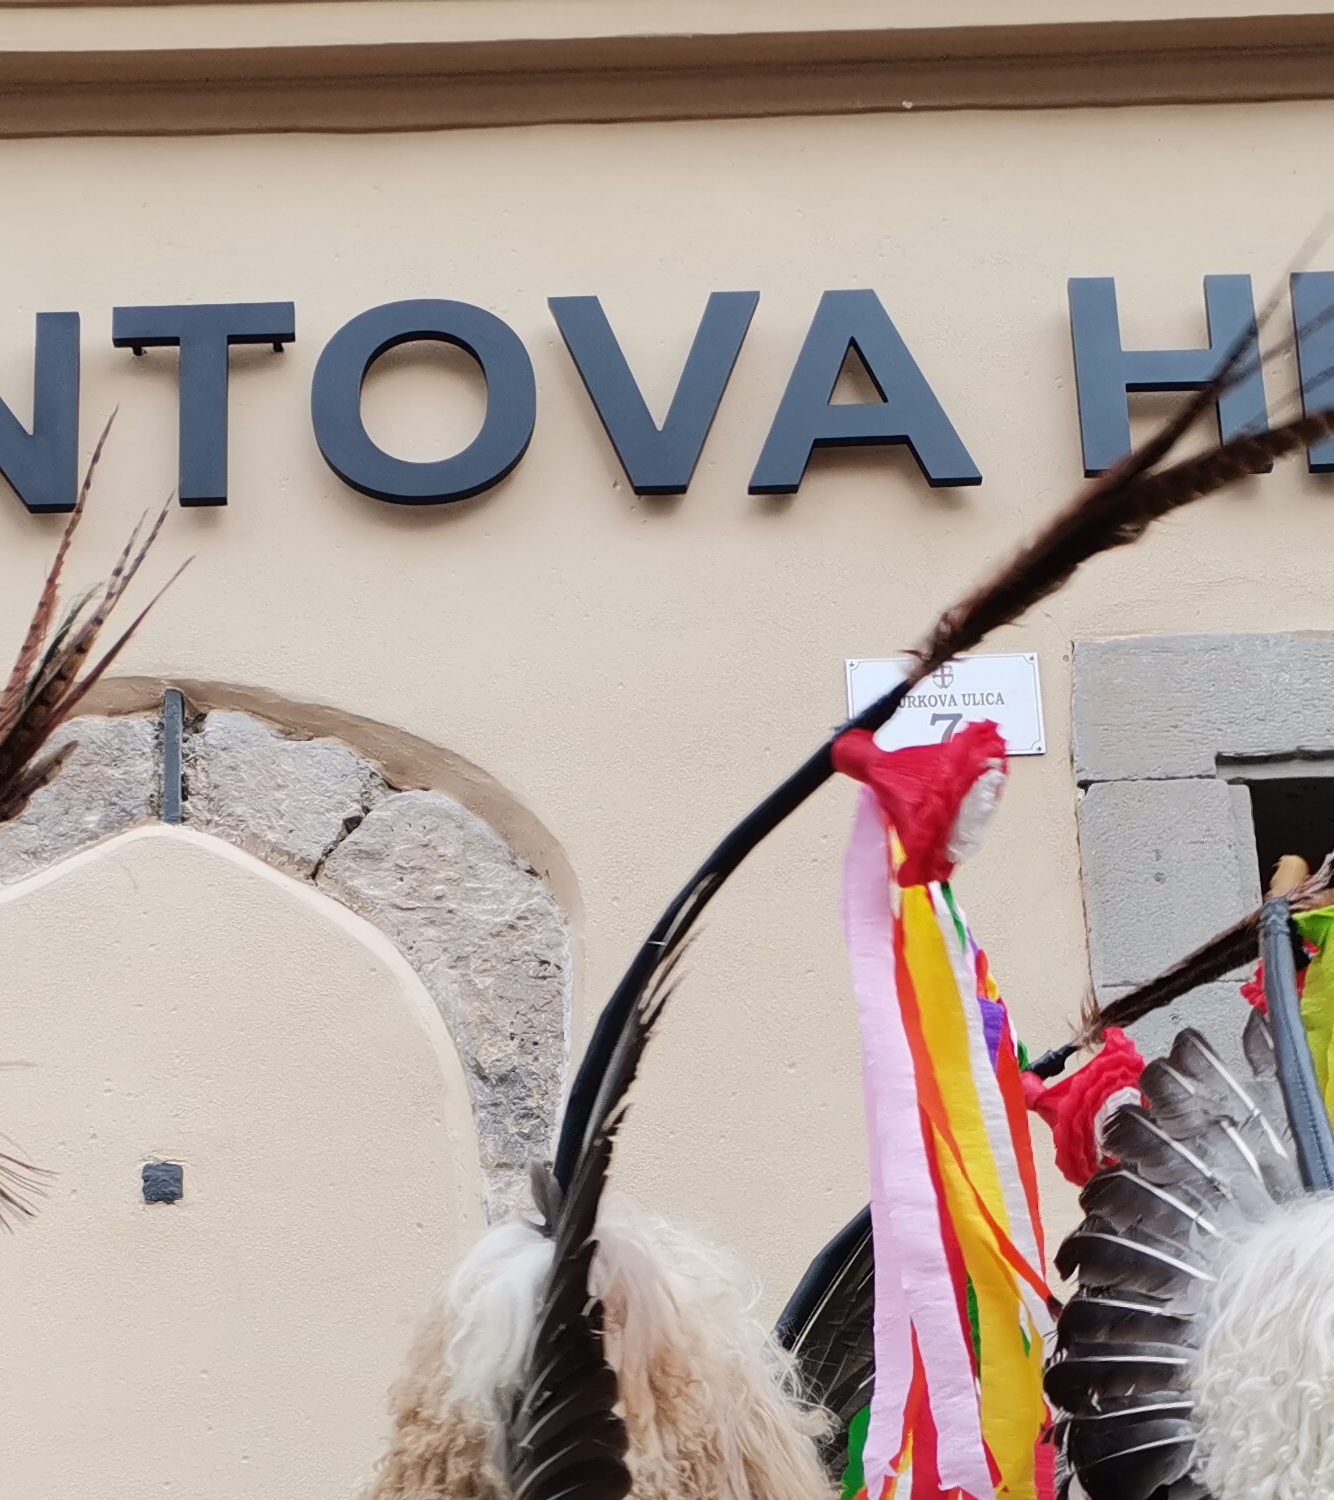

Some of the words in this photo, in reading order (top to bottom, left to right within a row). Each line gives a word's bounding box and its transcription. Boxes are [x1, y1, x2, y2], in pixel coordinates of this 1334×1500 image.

[898, 694, 958, 709] URKOVA
[962, 692, 1006, 706] ULICA
[929, 712, 964, 744] 7
